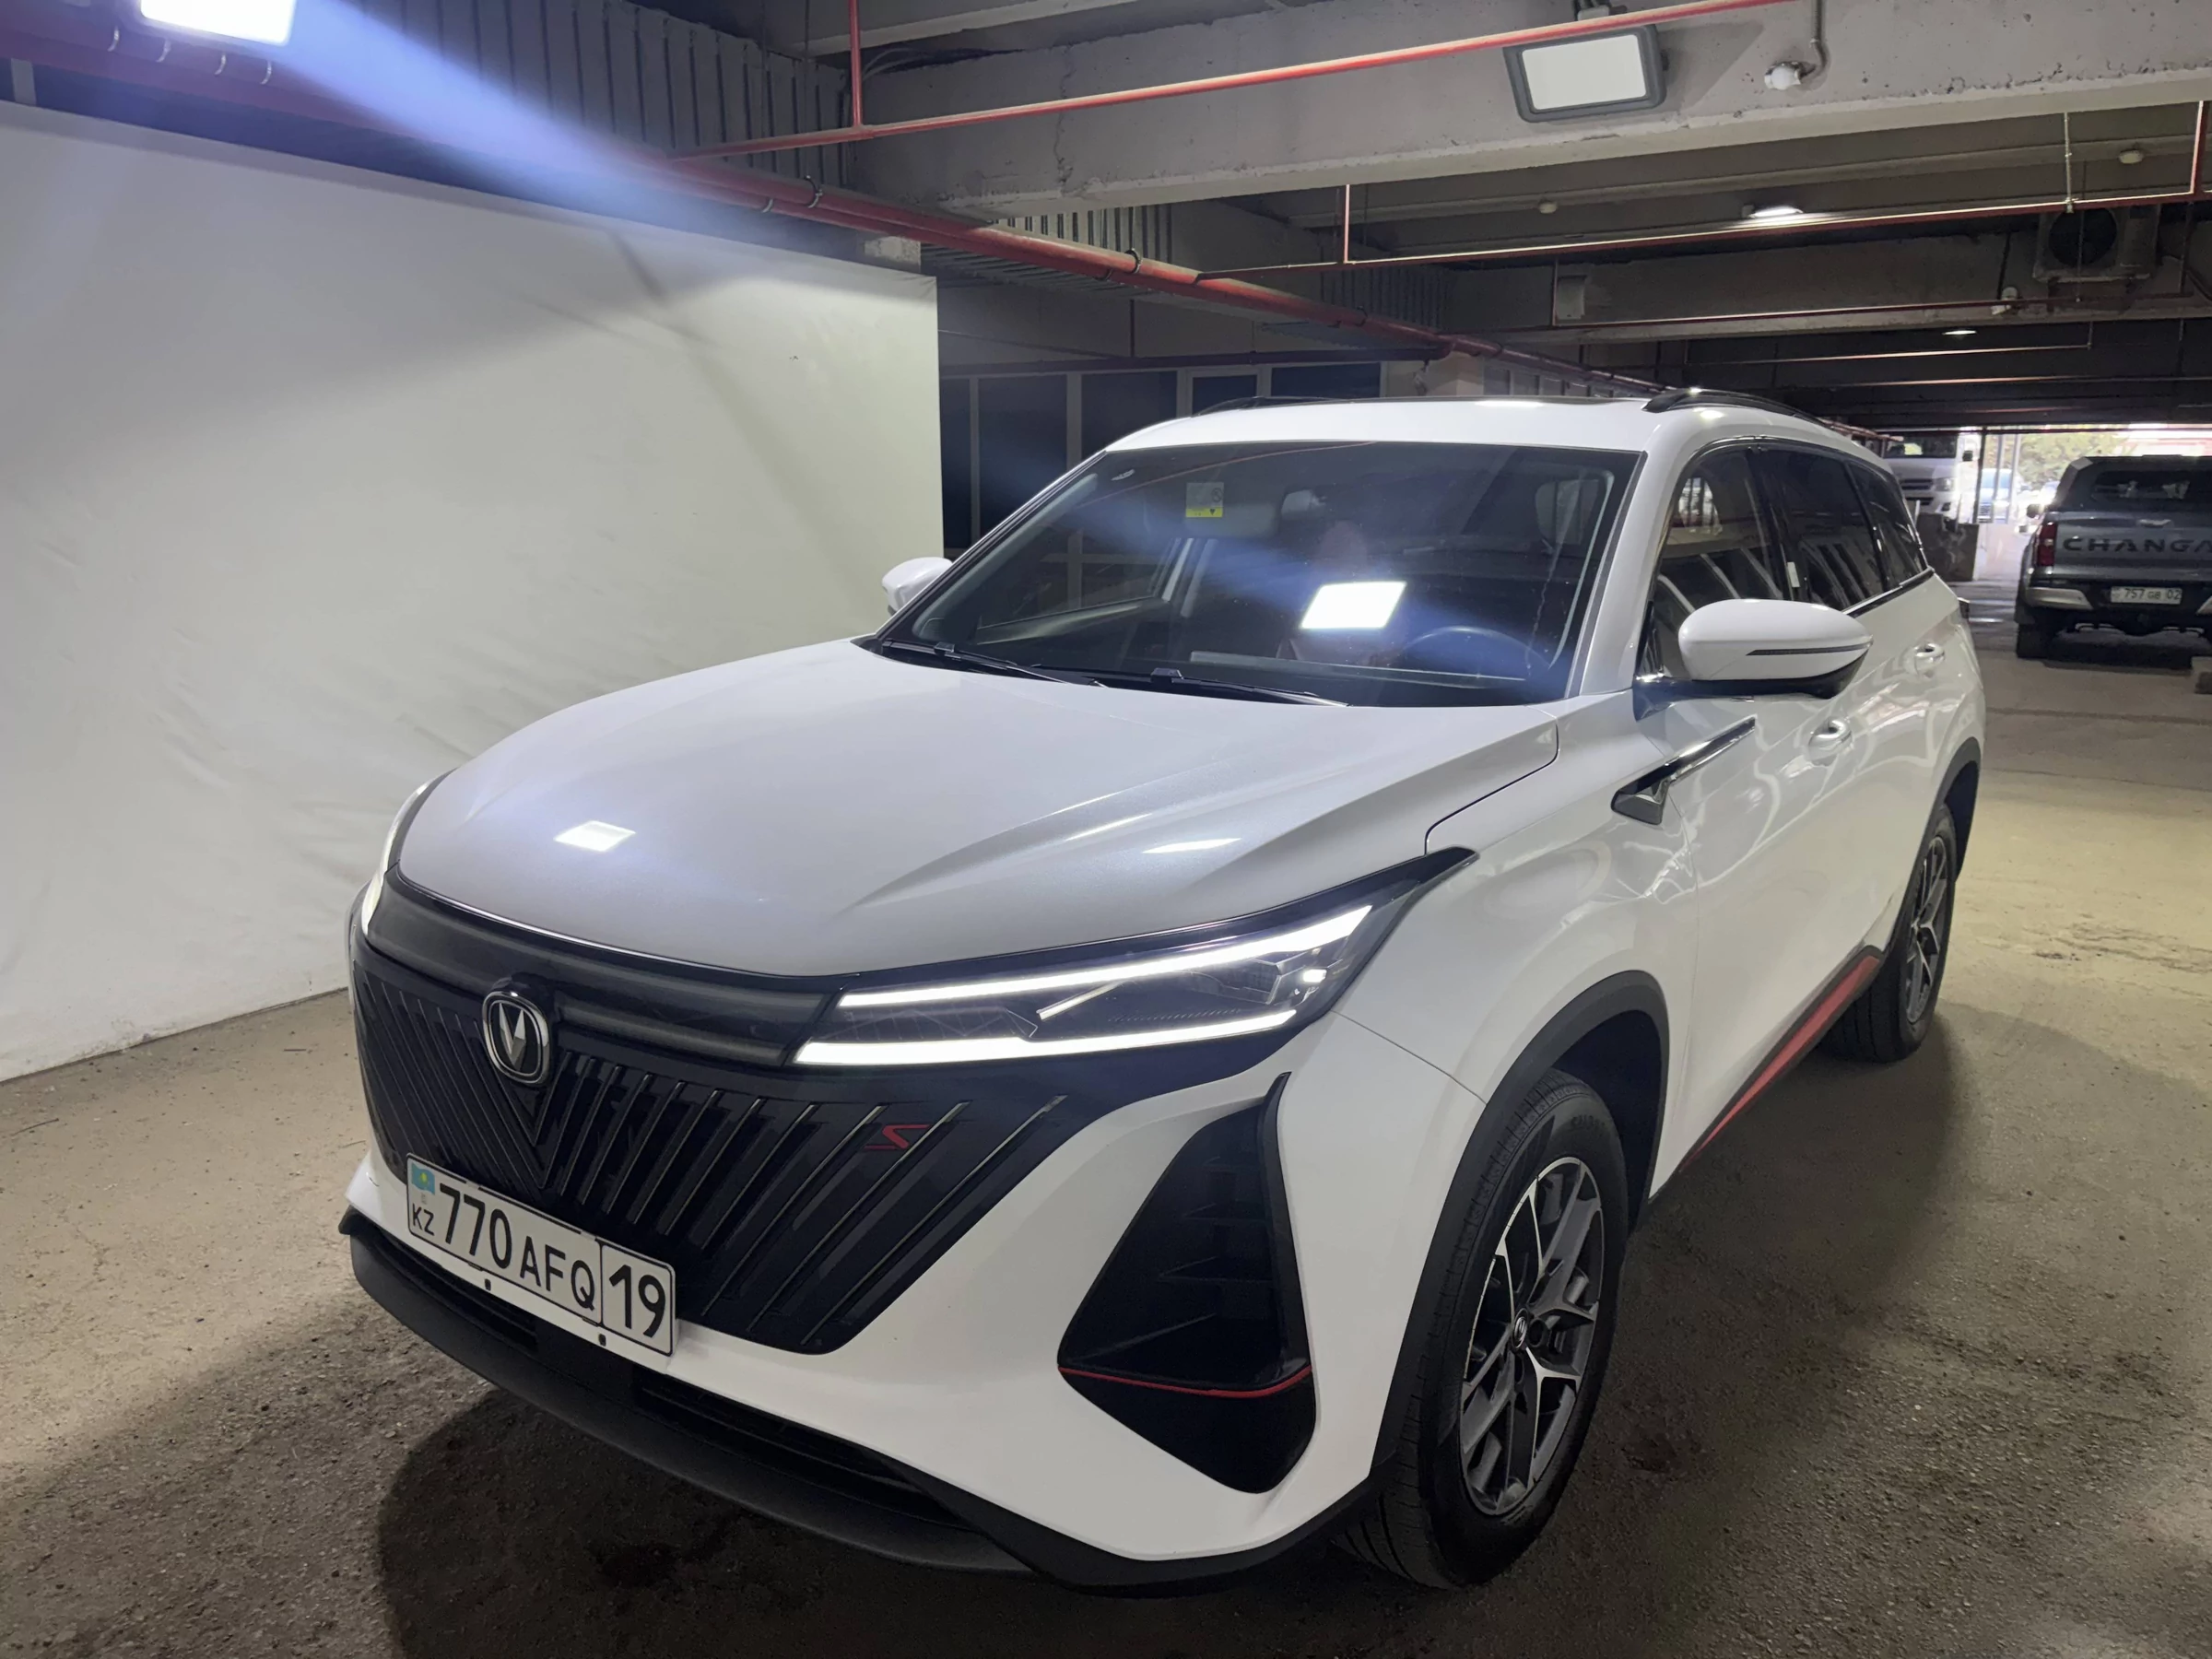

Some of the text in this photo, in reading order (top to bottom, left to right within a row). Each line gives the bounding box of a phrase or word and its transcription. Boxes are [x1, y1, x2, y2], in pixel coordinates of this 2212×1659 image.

[2124, 587, 2146, 600] 757
[2167, 589, 2183, 600] 02
[412, 1182, 666, 1339] KZ 770 AFQ 19
